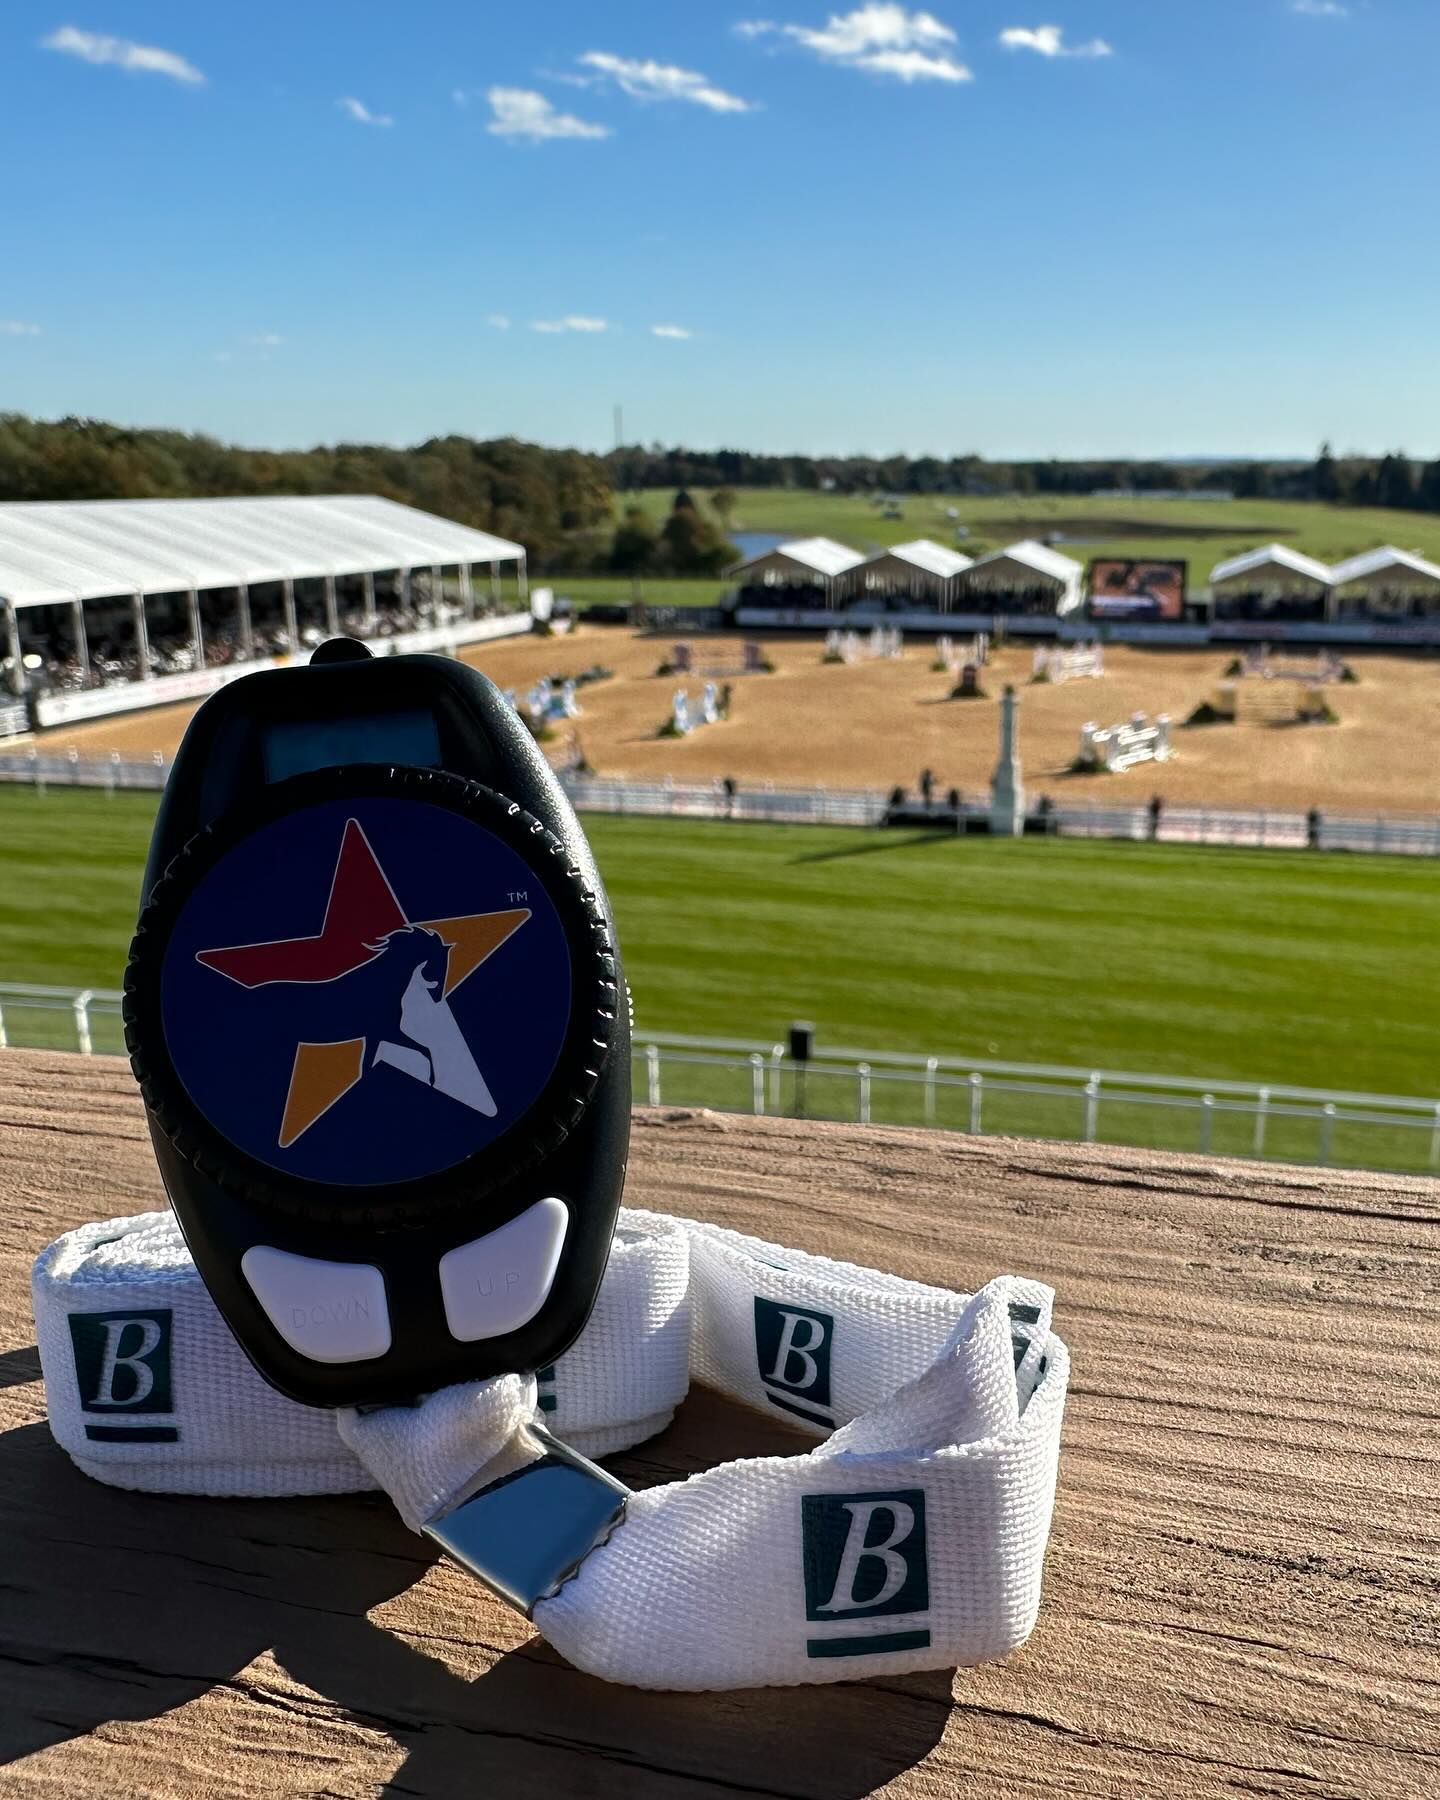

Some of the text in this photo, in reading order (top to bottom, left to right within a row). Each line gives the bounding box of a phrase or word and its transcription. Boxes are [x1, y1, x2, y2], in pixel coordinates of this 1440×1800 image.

[507, 891, 528, 903] TM
[476, 1271, 520, 1297] UP
[291, 1296, 370, 1329] DOWN
[88, 1318, 161, 1406] B
[765, 1310, 825, 1389] B
[816, 1500, 915, 1613] B
